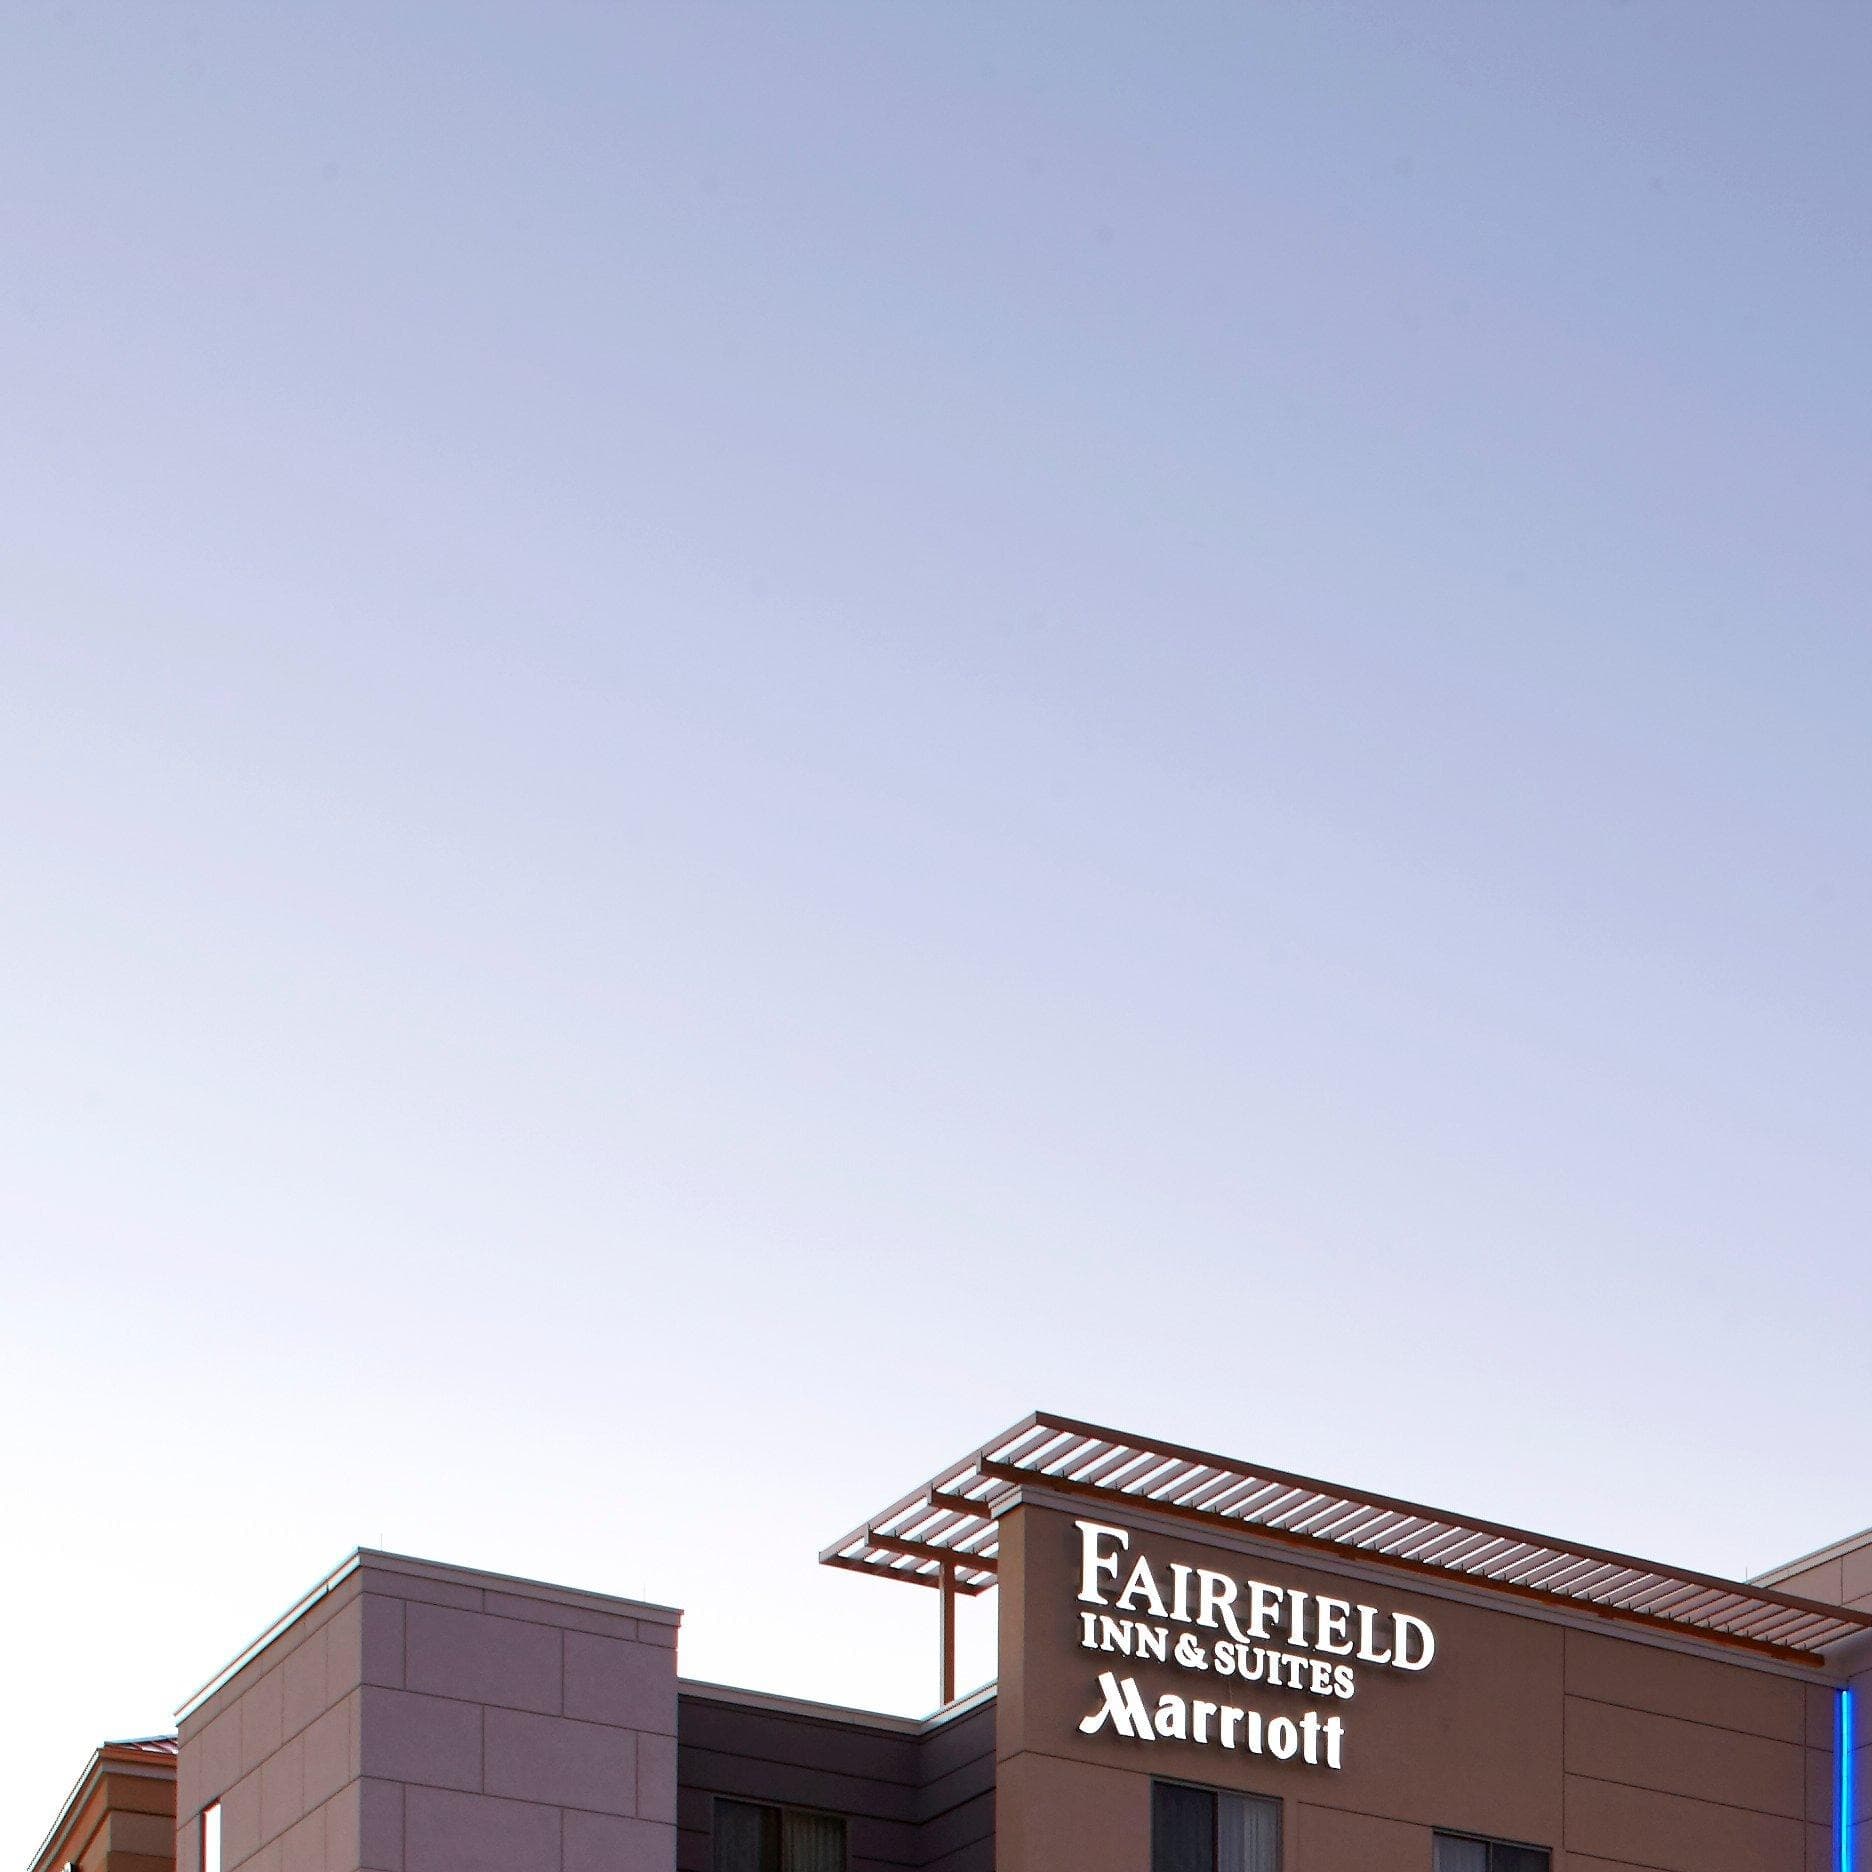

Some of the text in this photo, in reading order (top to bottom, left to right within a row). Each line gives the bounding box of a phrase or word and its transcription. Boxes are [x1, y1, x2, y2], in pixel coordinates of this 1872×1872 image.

[1074, 1520, 1436, 1672] FAIRFIELD
[1080, 1611, 1355, 1699] INN & SUITES
[1078, 1671, 1346, 1770] Marriott
